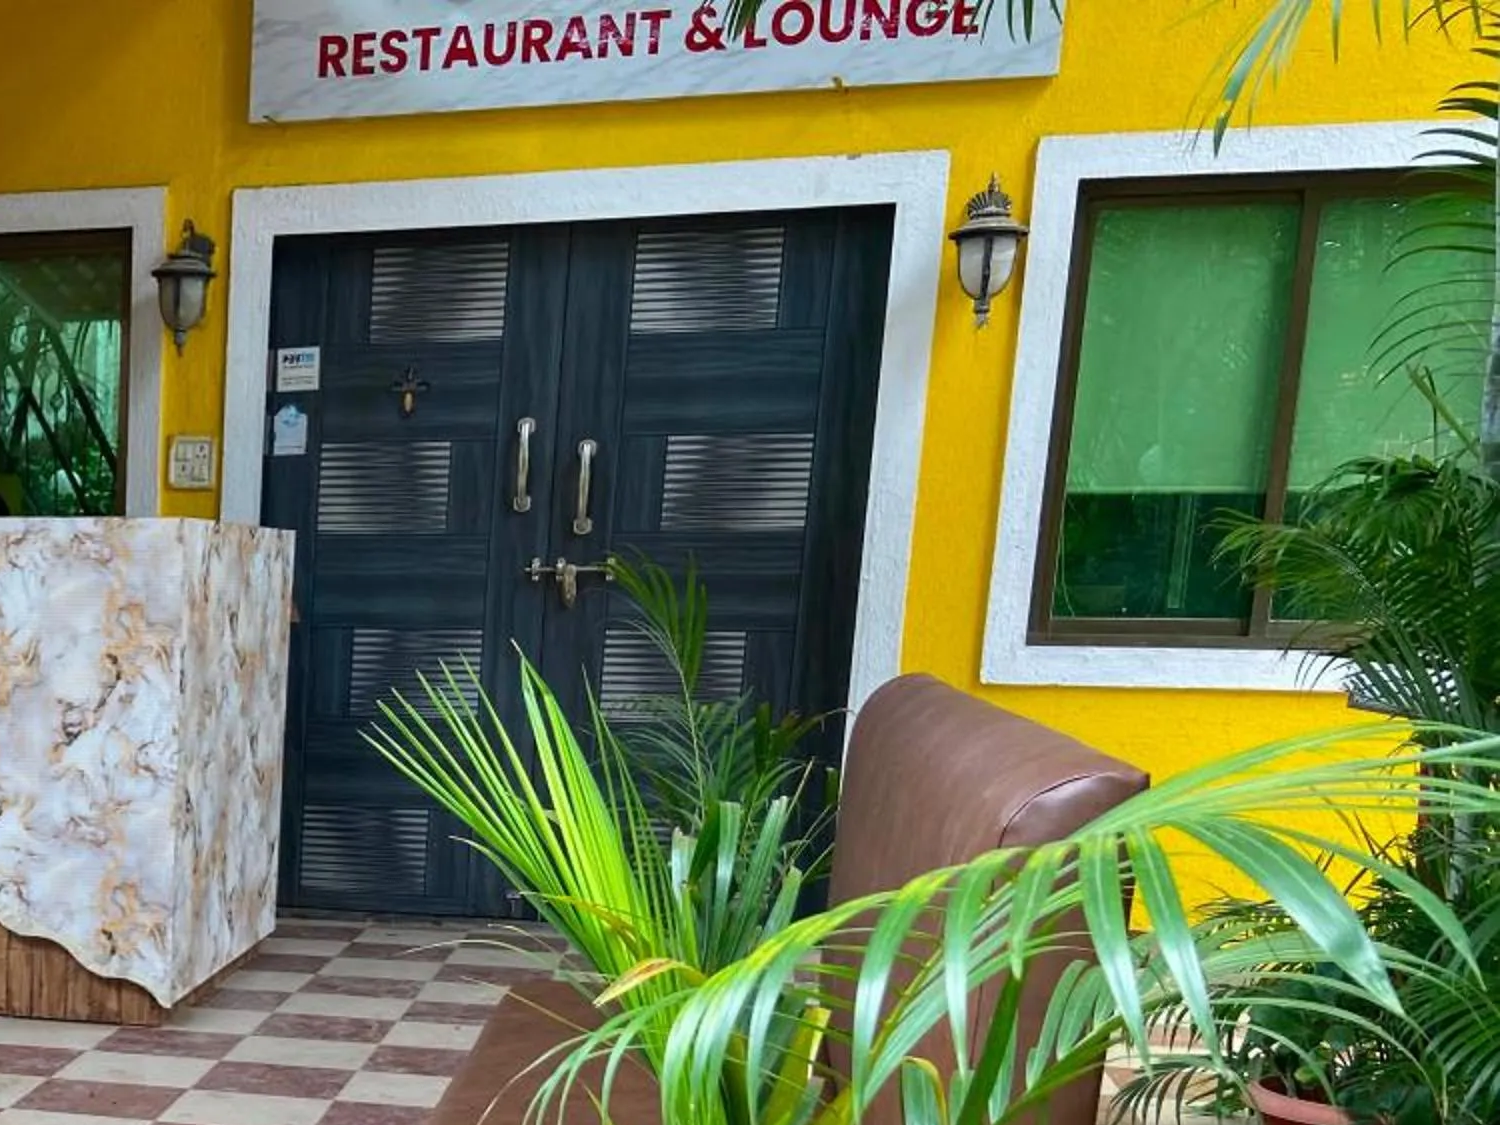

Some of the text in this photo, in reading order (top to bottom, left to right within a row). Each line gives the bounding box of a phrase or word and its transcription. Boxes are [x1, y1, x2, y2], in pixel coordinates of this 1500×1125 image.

[319, 0, 979, 78] RESTAURANT & LOUNGE
